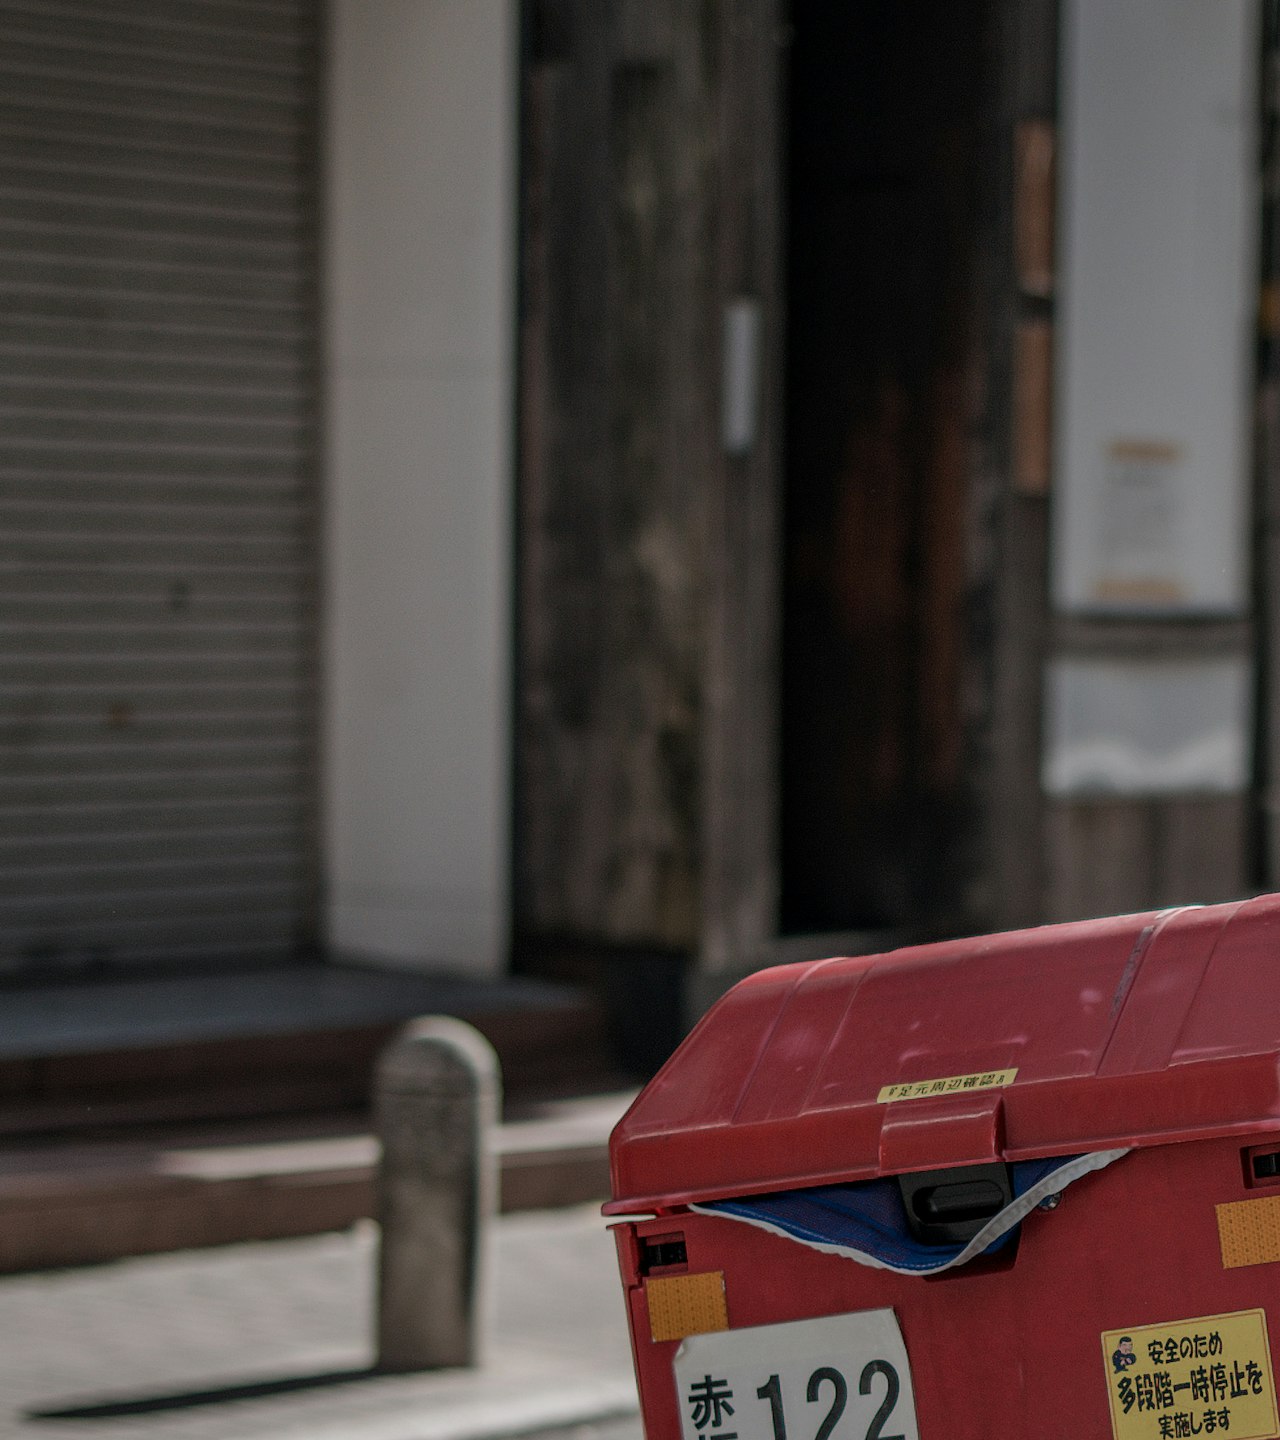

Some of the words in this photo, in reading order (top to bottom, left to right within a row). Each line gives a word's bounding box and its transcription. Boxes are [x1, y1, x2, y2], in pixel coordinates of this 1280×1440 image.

[1147, 1331, 1223, 1365] 安全のため
[1117, 1360, 1263, 1414] 多段階一時停止を
[1158, 1407, 1231, 1440] 実施します
